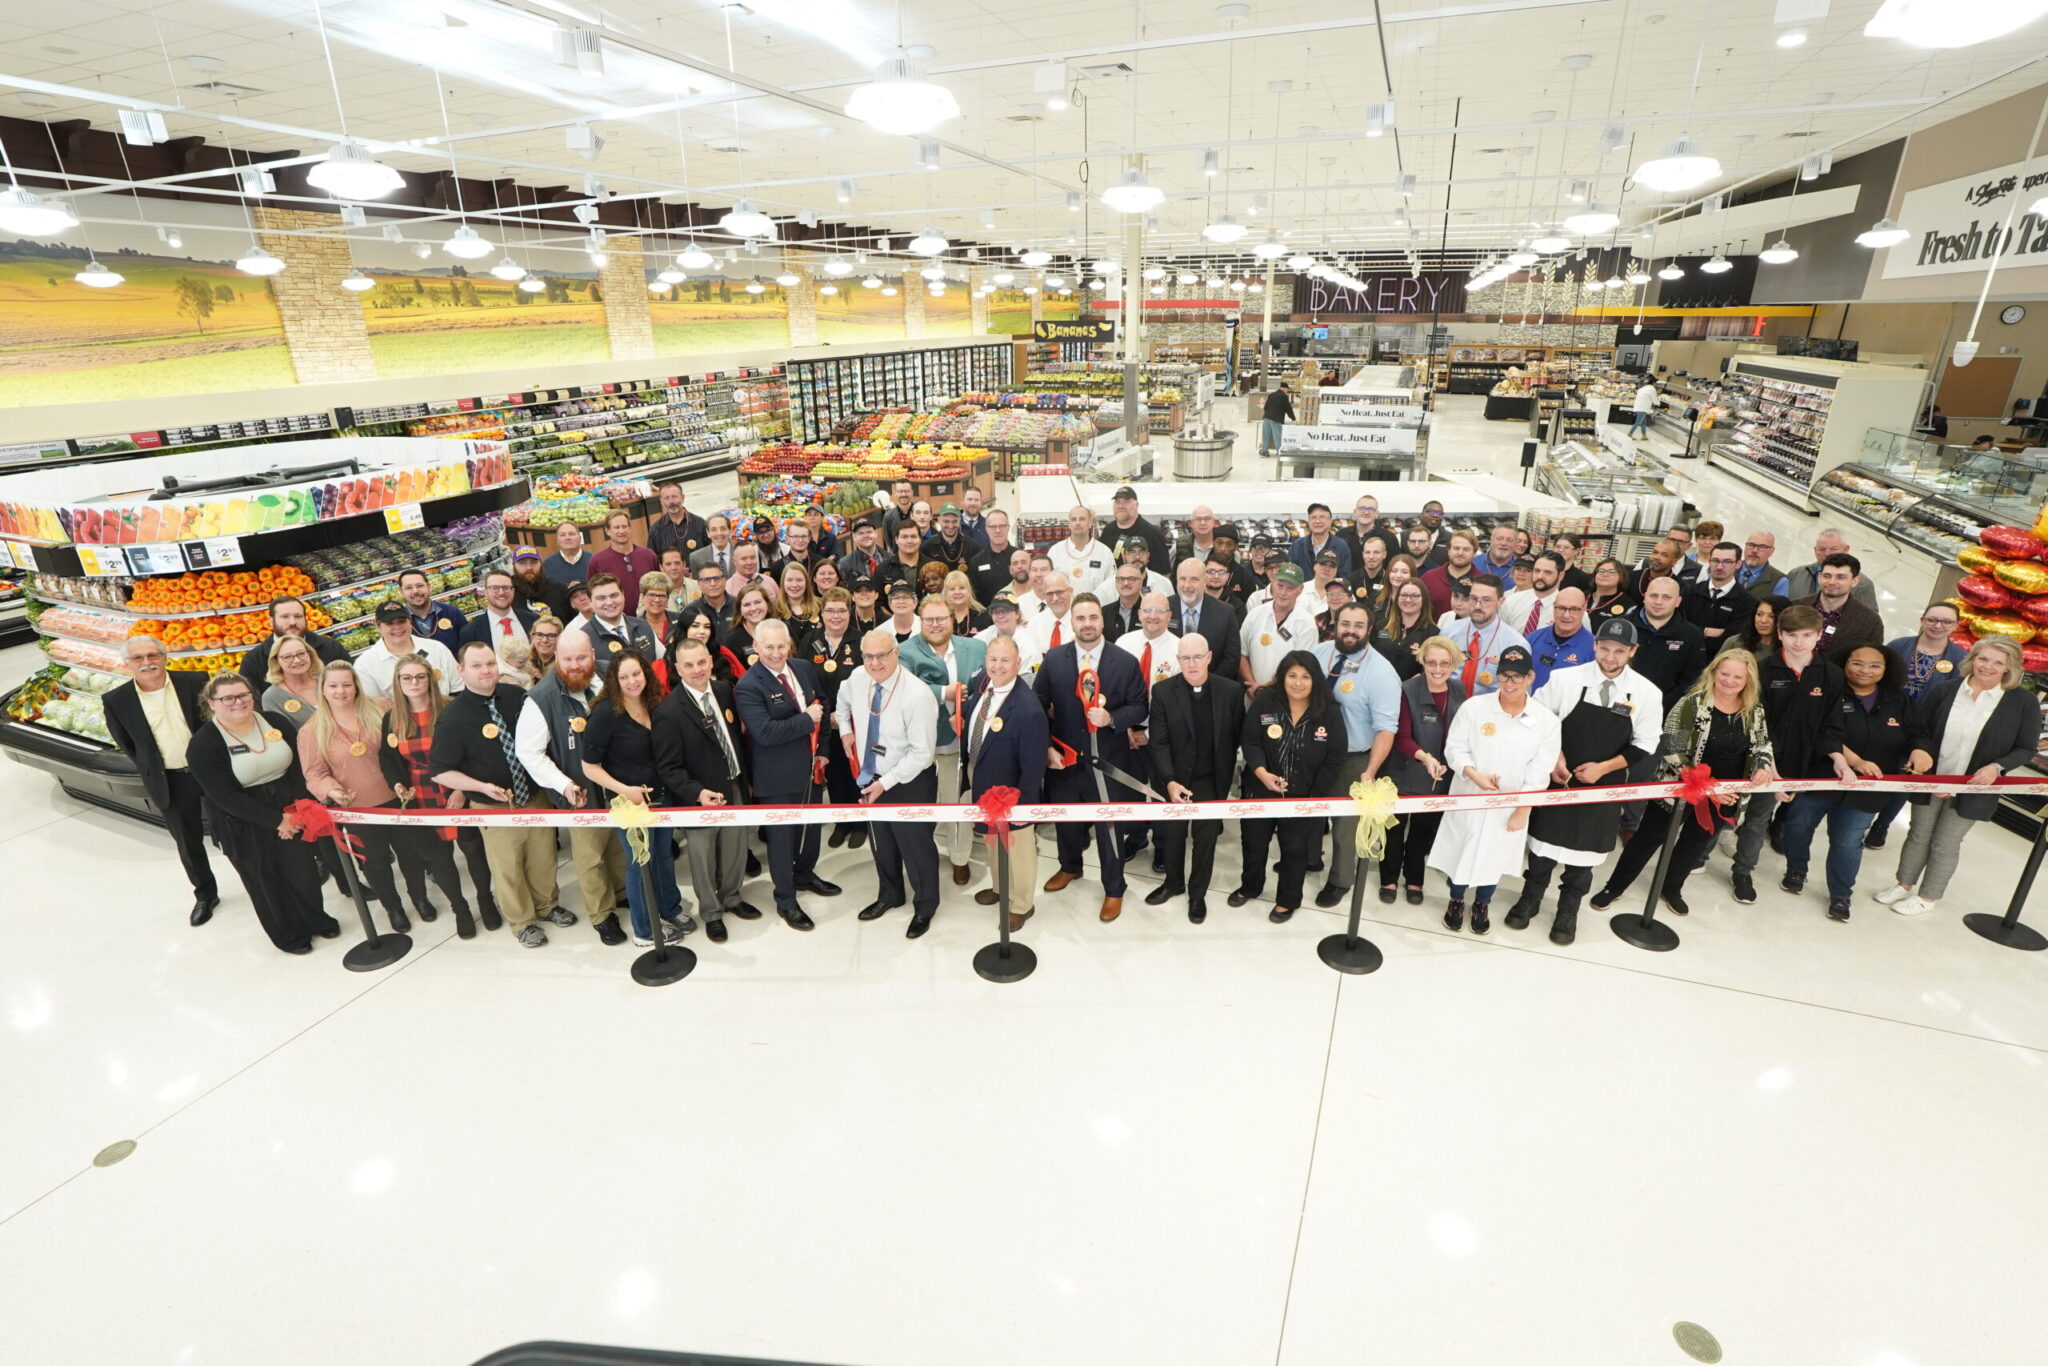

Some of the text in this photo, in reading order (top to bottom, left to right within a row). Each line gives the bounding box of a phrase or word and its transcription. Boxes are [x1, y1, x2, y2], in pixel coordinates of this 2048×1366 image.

[1916, 219, 1983, 266] Fresh
[1981, 221, 2013, 259] to
[1310, 277, 1449, 311] BAKERY
[1047, 322, 1097, 339] Bananas
[1374, 410, 1390, 418] Just
[1307, 432, 1319, 440] No
[1348, 433, 1368, 443] Just
[1370, 435, 1387, 443] Eat
